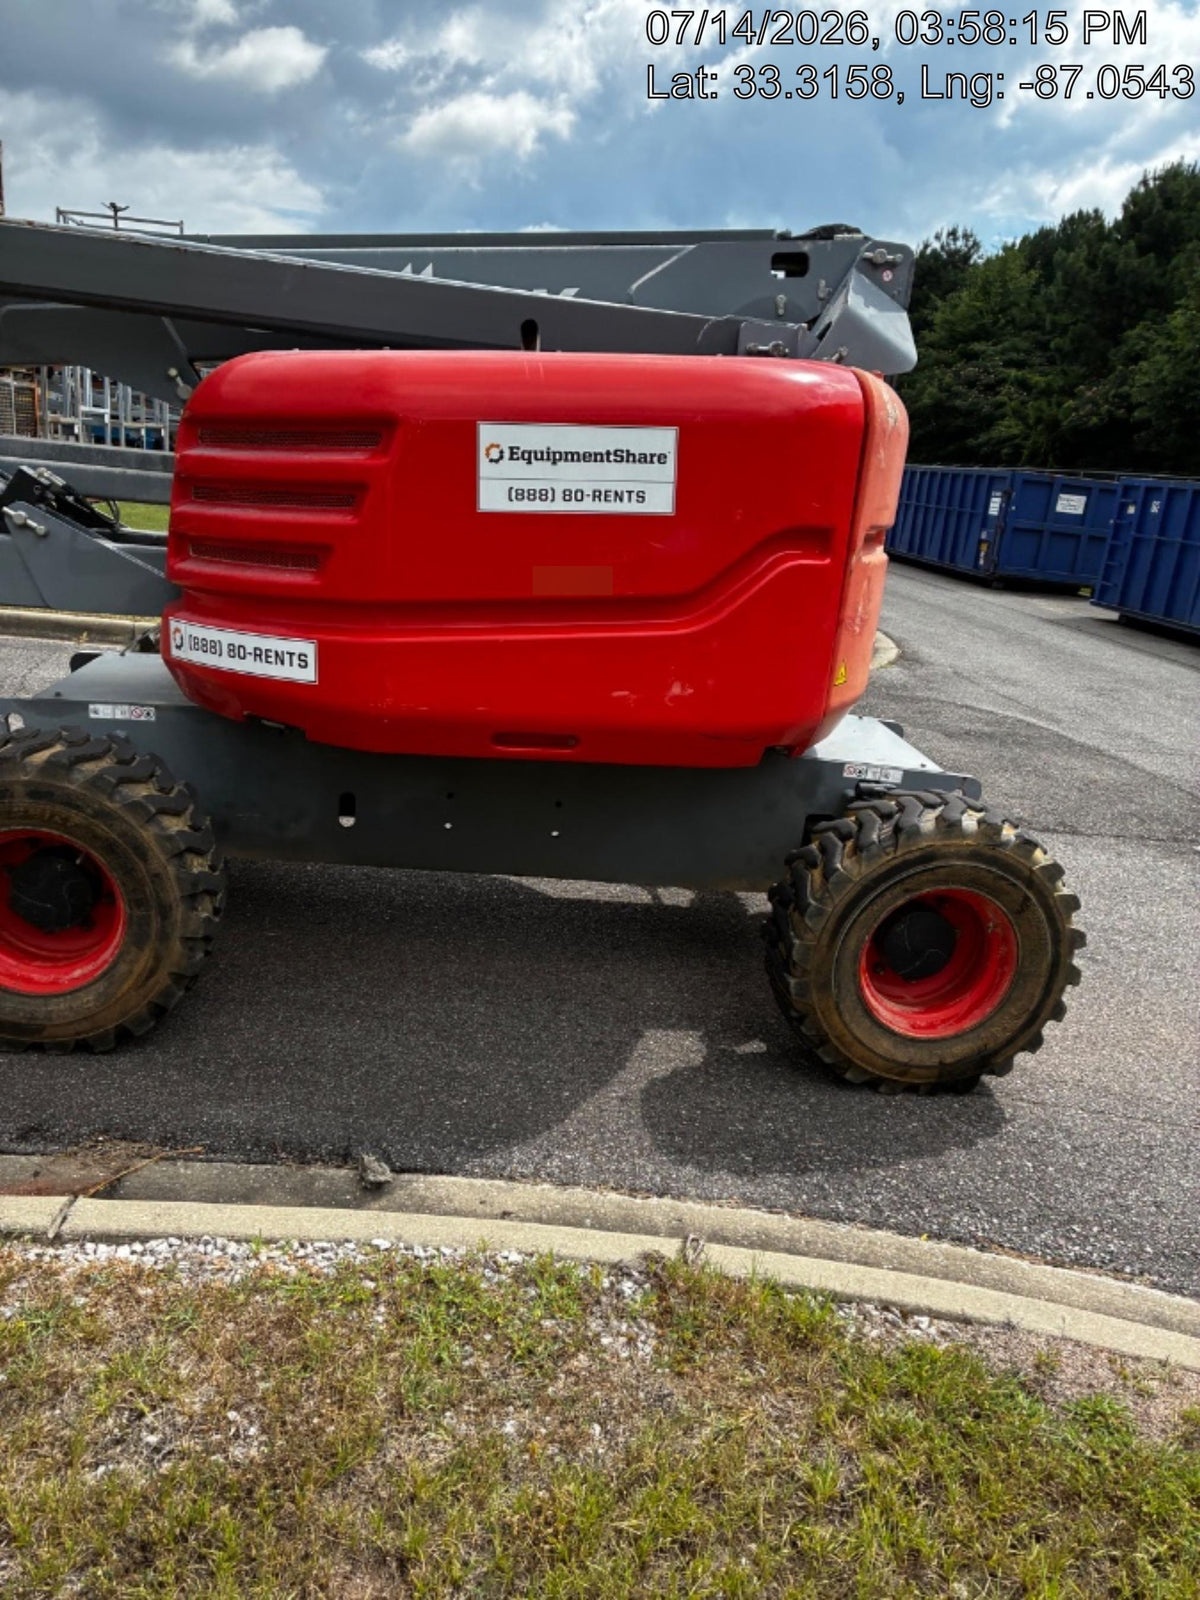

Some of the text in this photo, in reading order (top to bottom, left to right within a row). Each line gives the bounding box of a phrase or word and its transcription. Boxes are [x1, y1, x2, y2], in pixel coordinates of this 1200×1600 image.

[508, 446, 668, 466] EquipmentShare
[508, 486, 646, 503] (888) 80-RENTS
[188, 634, 309, 669] (888) 80-RENTS
